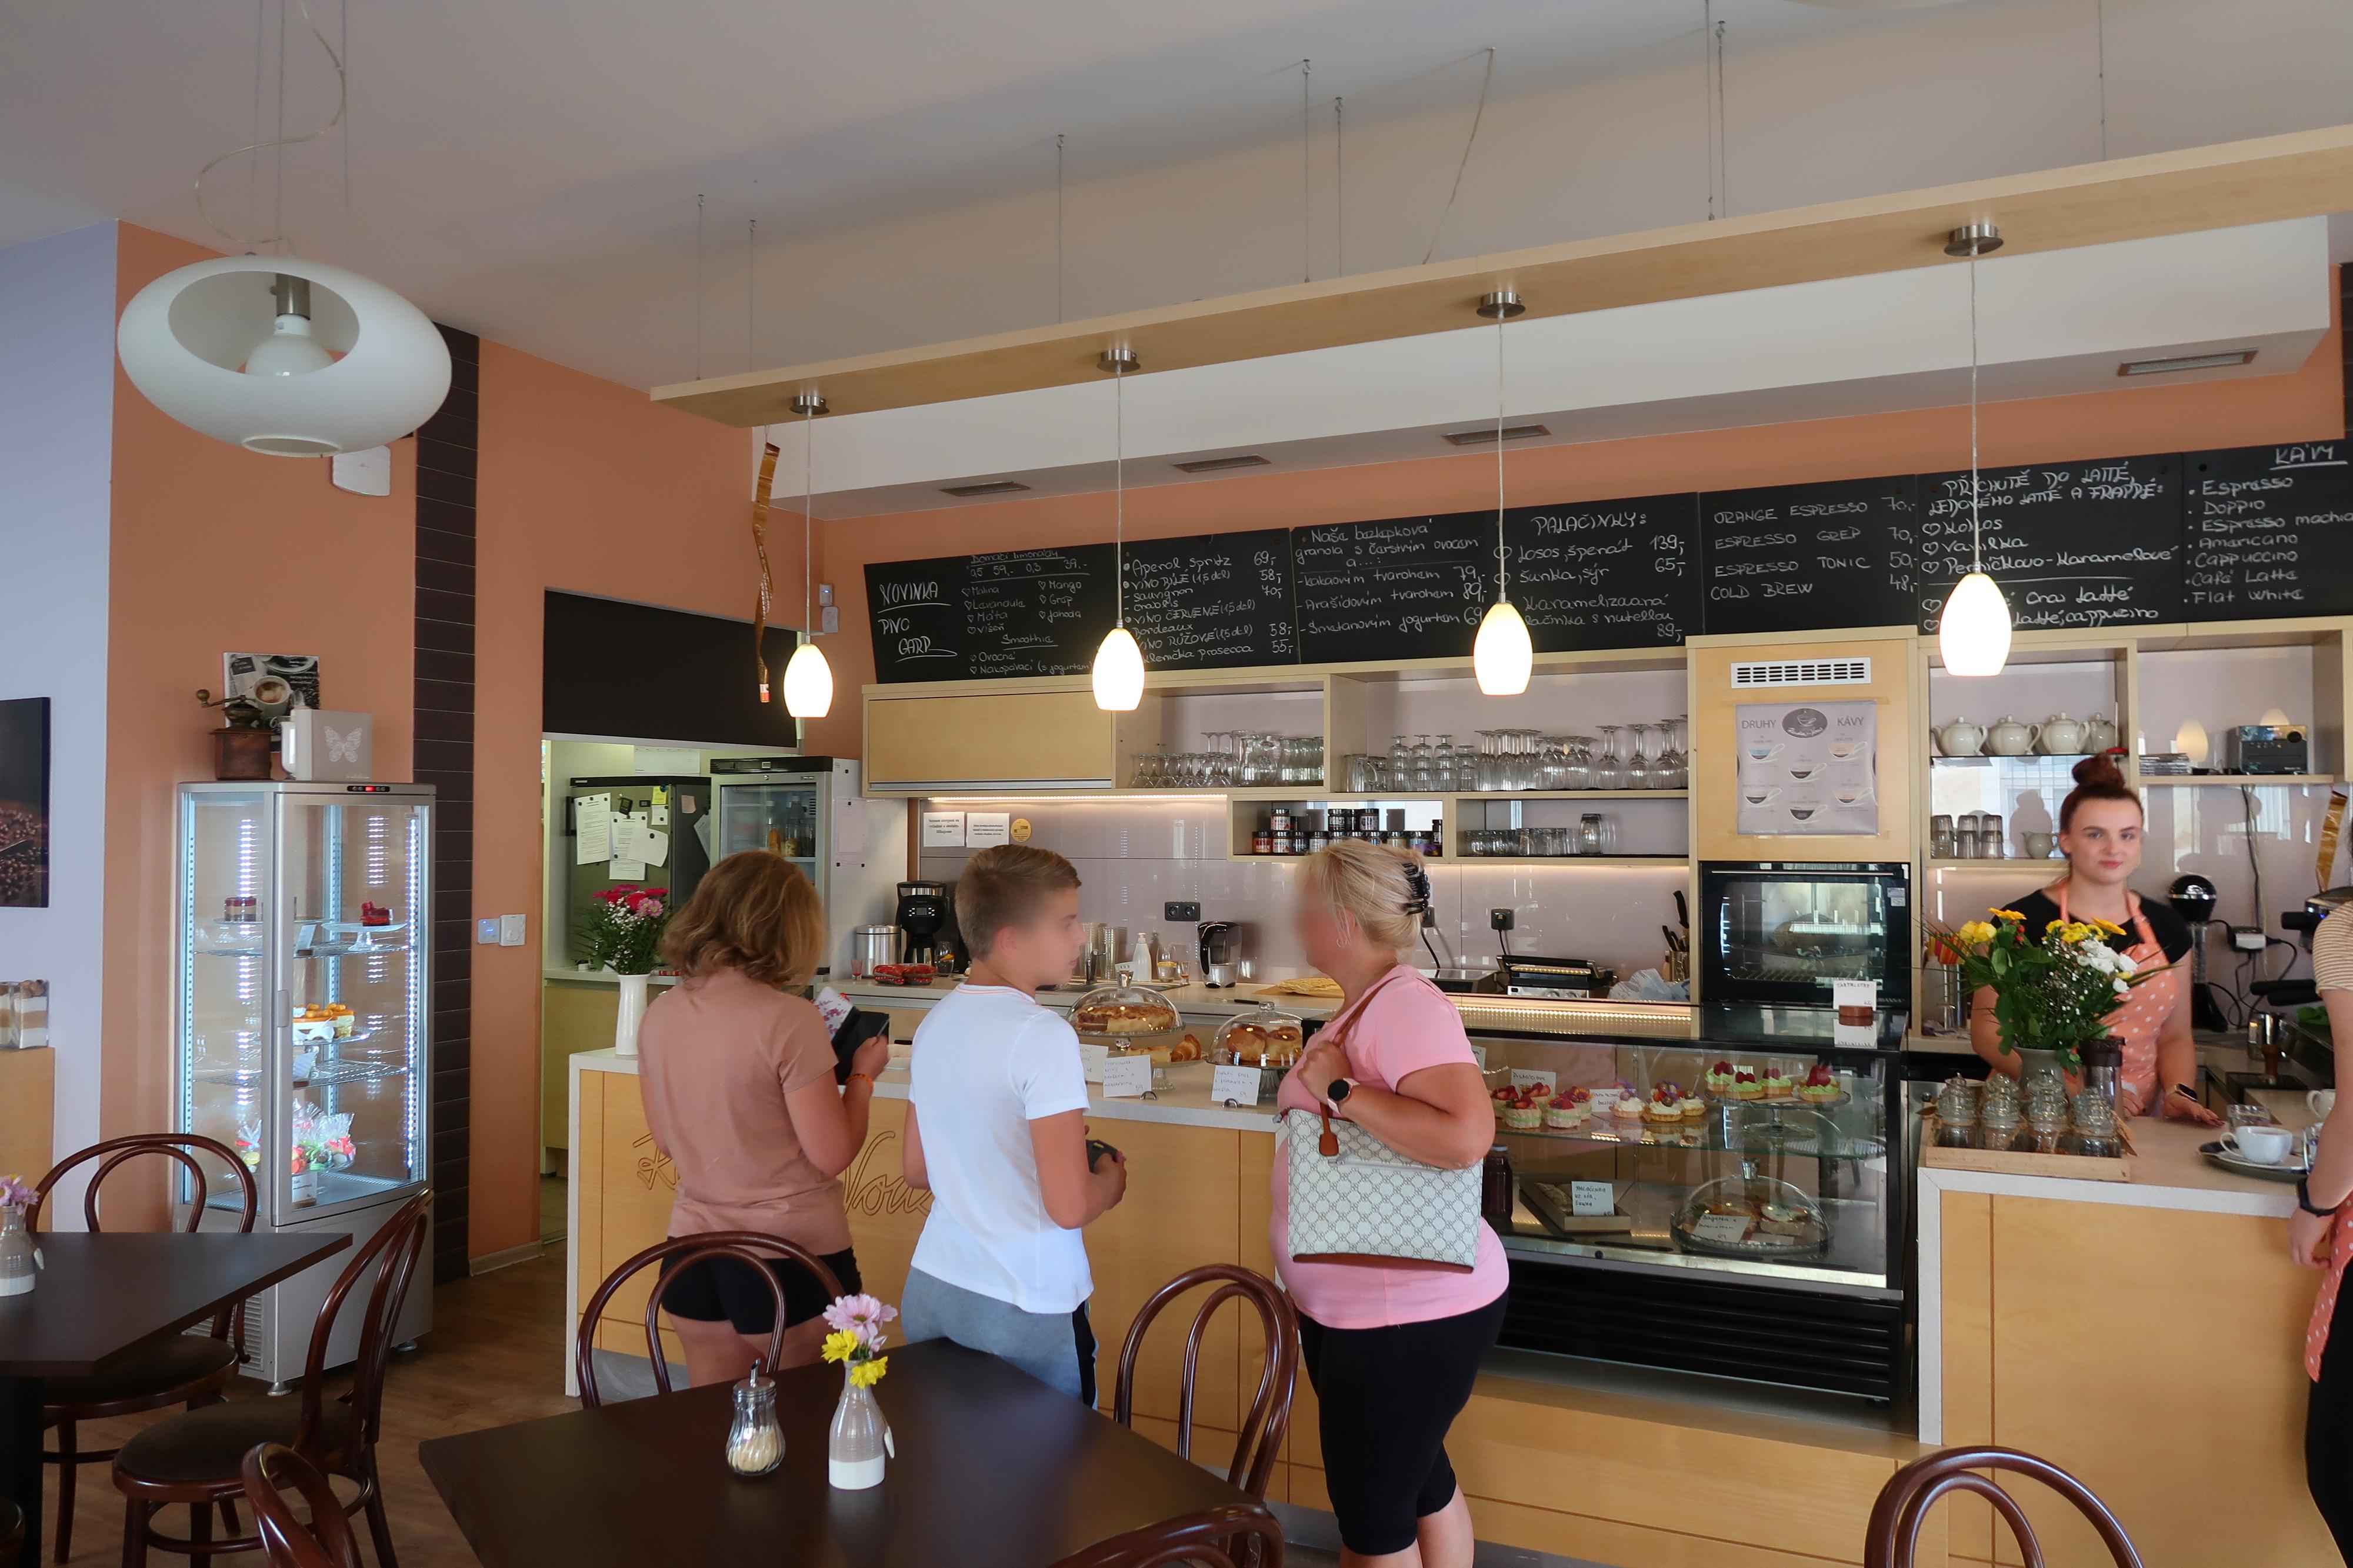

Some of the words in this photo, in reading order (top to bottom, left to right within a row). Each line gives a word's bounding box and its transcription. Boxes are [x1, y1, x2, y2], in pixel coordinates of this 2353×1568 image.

[2275, 443, 2335, 465] KÁVY
[2041, 471, 2071, 490] DO
[2070, 486, 2084, 500] A
[1714, 508, 1778, 524] ORANGE
[1789, 502, 1868, 517] ESPRESSO
[1311, 526, 1349, 543] Naše
[1355, 518, 1433, 543] bezlepková
[1715, 533, 1797, 549] ESPRESSO
[1816, 526, 1862, 542] GREP
[2198, 534, 2298, 550] Americano
[1295, 546, 1344, 565] granola
[1354, 546, 1362, 555] s
[1368, 539, 1425, 555] čerstvým
[1434, 538, 1479, 549] ovocem
[2194, 551, 2299, 568] Cappuccino
[1025, 562, 1041, 573] 0,3
[1132, 557, 1181, 579] Aperol
[1189, 554, 1232, 573] Spritz
[1715, 561, 1799, 578] ESPRESSO
[1816, 556, 1872, 569] TONIC
[1373, 568, 1441, 582] tvarohem
[2191, 569, 2234, 587] Café
[2245, 568, 2298, 583] Latte
[879, 581, 938, 606] NOVINKA
[972, 586, 1000, 596] Malina
[1049, 580, 1082, 593] Mango
[1390, 588, 1454, 600] tvarohem
[1710, 585, 1750, 600] COLD
[1761, 581, 1814, 598] BREW
[973, 599, 1026, 610] Lavandule
[2191, 590, 2235, 605] Flat
[977, 609, 1008, 622] Máta
[1047, 610, 1082, 623] Jahoda
[1398, 612, 1460, 633] jogurtem
[1592, 613, 1599, 624] s
[1001, 634, 1054, 645] Smoothie
[1131, 623, 1194, 640] Bordeaux
[978, 651, 1016, 662] Ovocné
[1741, 719, 1777, 729] DRUHY
[1837, 715, 1864, 726] KÁVY
